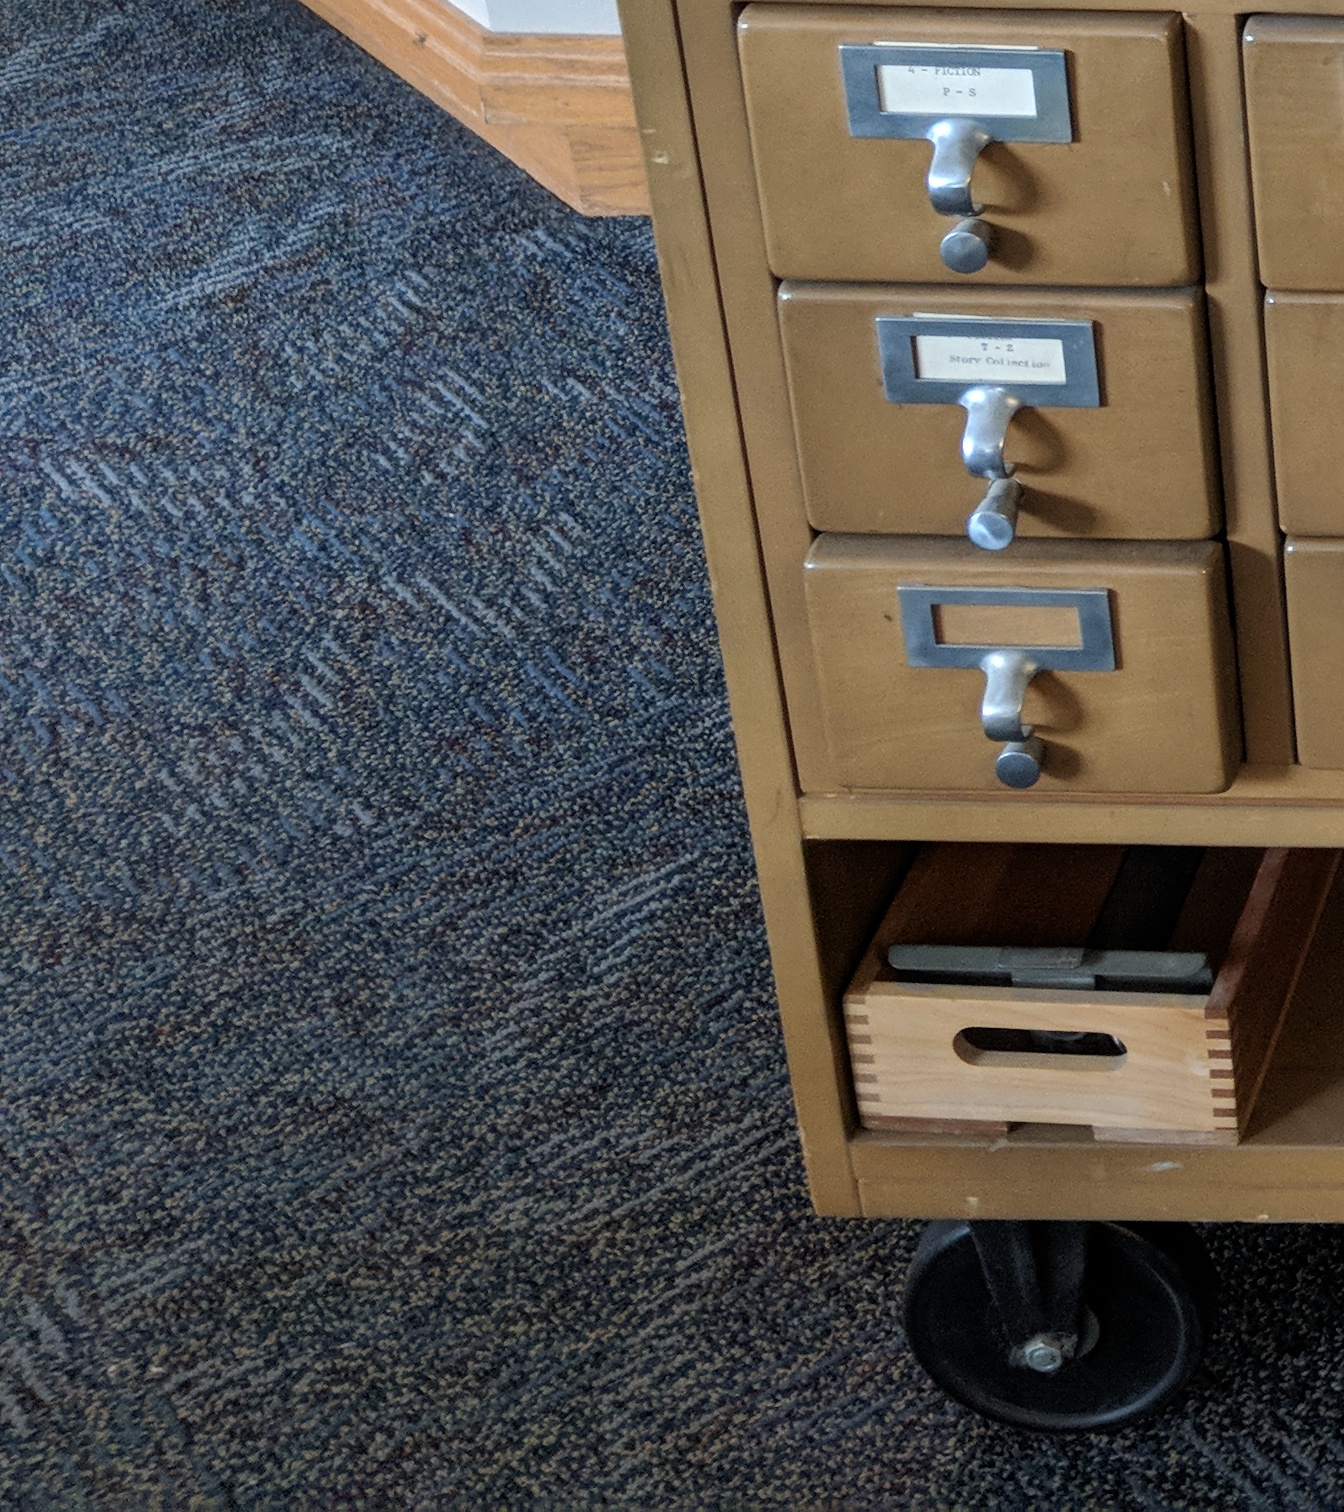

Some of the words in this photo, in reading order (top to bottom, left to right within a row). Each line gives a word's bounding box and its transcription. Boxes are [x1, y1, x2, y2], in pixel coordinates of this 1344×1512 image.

[935, 67, 981, 76] FICTION
[943, 87, 951, 97] P
[969, 87, 976, 97] S
[950, 355, 981, 364] Story
[986, 356, 1050, 368] Collection
